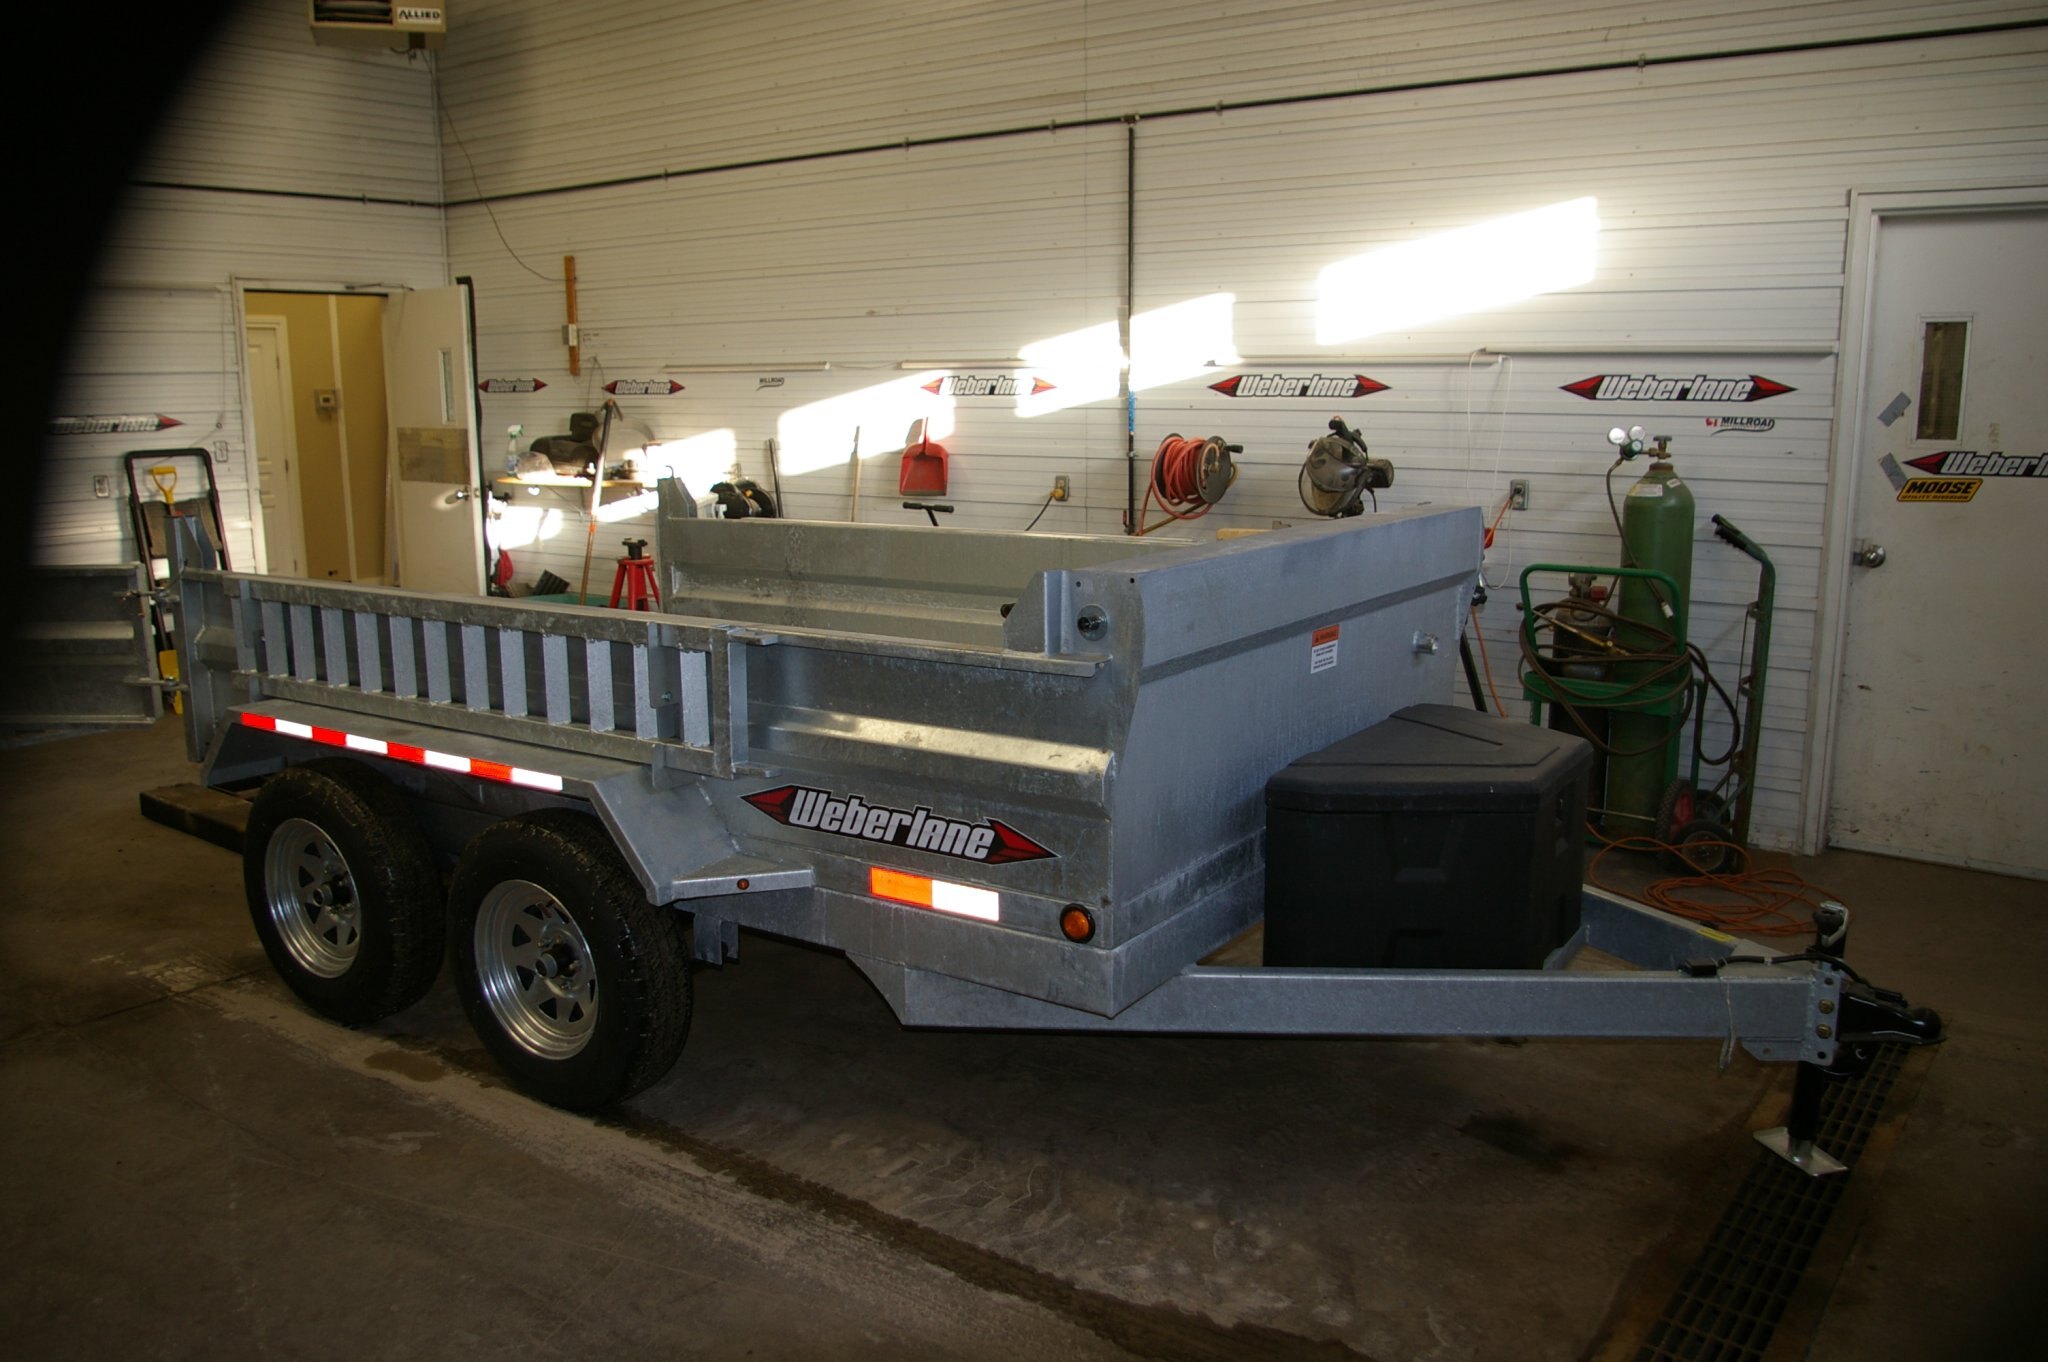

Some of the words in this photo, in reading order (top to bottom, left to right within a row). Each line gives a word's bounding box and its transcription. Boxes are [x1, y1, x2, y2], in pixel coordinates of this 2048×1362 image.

[399, 9, 441, 20] ALLIED
[1236, 374, 1359, 397] Weberlane
[1596, 374, 1754, 401] Weberlane
[1906, 481, 1977, 494] MOOSE
[788, 788, 996, 860] Weberlane
